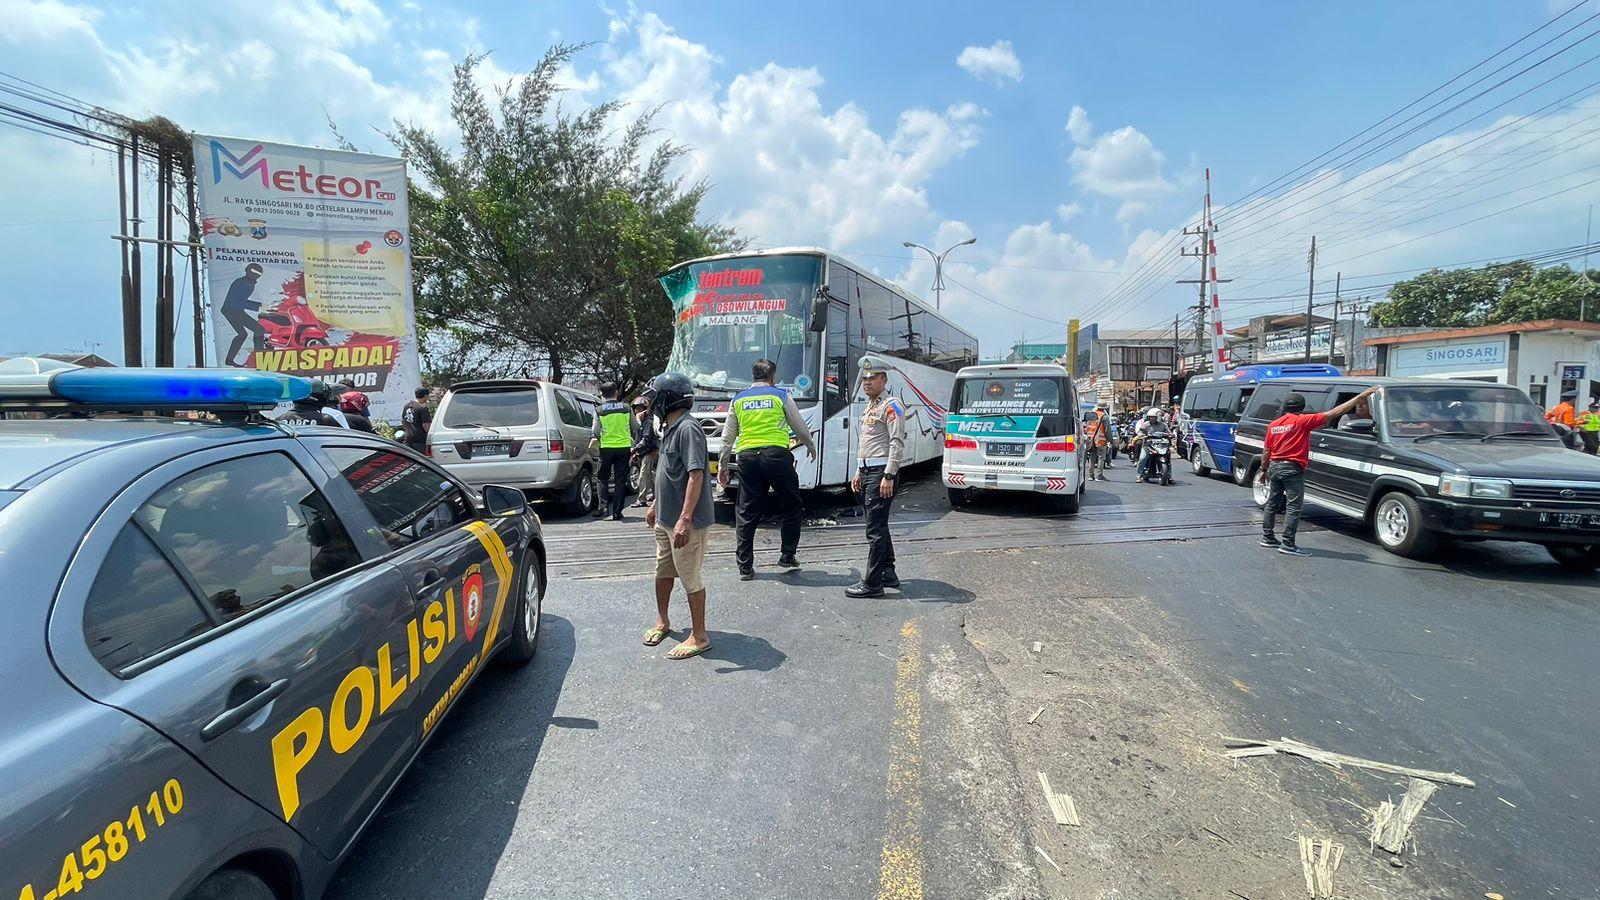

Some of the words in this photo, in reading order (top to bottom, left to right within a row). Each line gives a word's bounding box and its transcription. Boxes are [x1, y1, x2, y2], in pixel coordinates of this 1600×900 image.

[210, 140, 381, 199] Meteor
[235, 197, 254, 206] RAYA
[255, 199, 293, 208] SINGOSARI
[316, 204, 345, 213] (SETELAH
[346, 206, 368, 215] LAMPU
[369, 208, 394, 217] MERAH)
[216, 247, 248, 255] PELAKU
[717, 300, 786, 312] OSOWILANGUN
[709, 315, 757, 325] MALANG
[255, 345, 393, 372] WASPADA!
[1426, 346, 1498, 360] SINGOSARI
[602, 402, 624, 410] POLISI
[742, 400, 772, 410] POLISI
[972, 400, 1024, 408] AMBULANCE
[958, 421, 994, 432] MSR
[1558, 513, 1581, 524] 1257
[272, 588, 456, 822] POLISI
